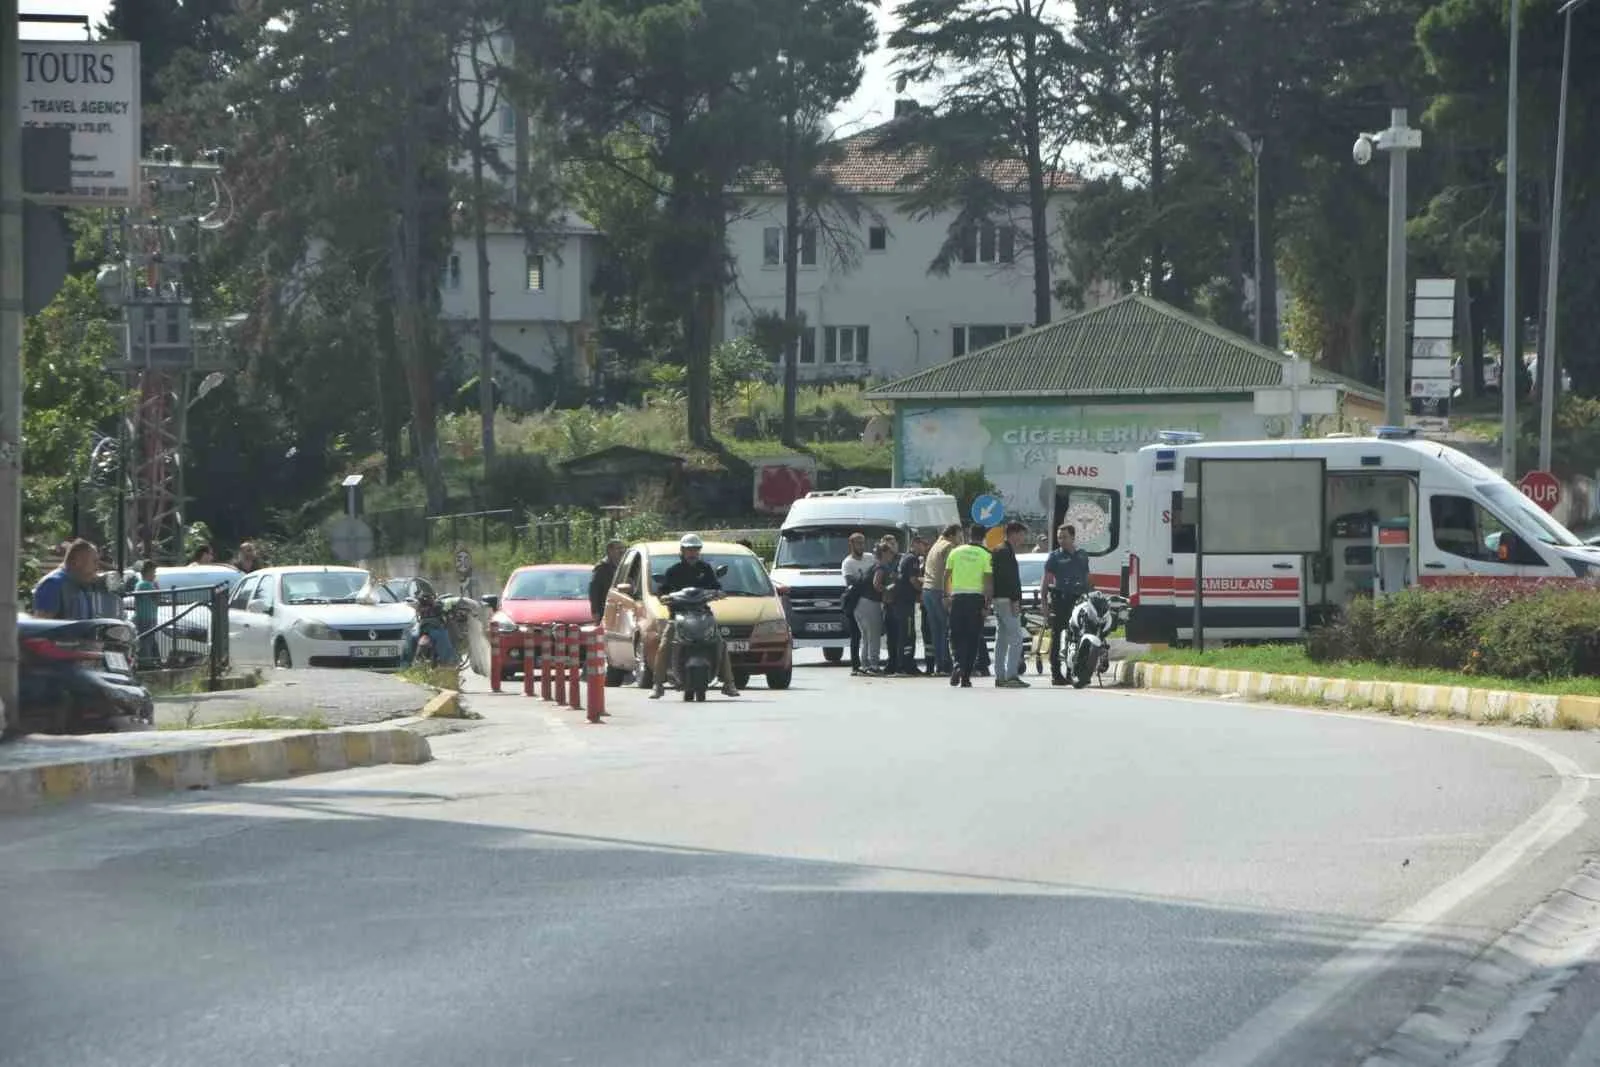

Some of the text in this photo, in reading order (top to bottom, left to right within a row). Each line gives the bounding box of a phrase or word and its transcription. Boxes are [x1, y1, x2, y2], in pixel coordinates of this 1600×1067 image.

[21, 52, 114, 84] TOURS
[31, 99, 77, 113] TRAVEL
[80, 100, 129, 114] AGENCY
[1057, 465, 1099, 477] LANS
[1202, 578, 1273, 591] AMBULANS
